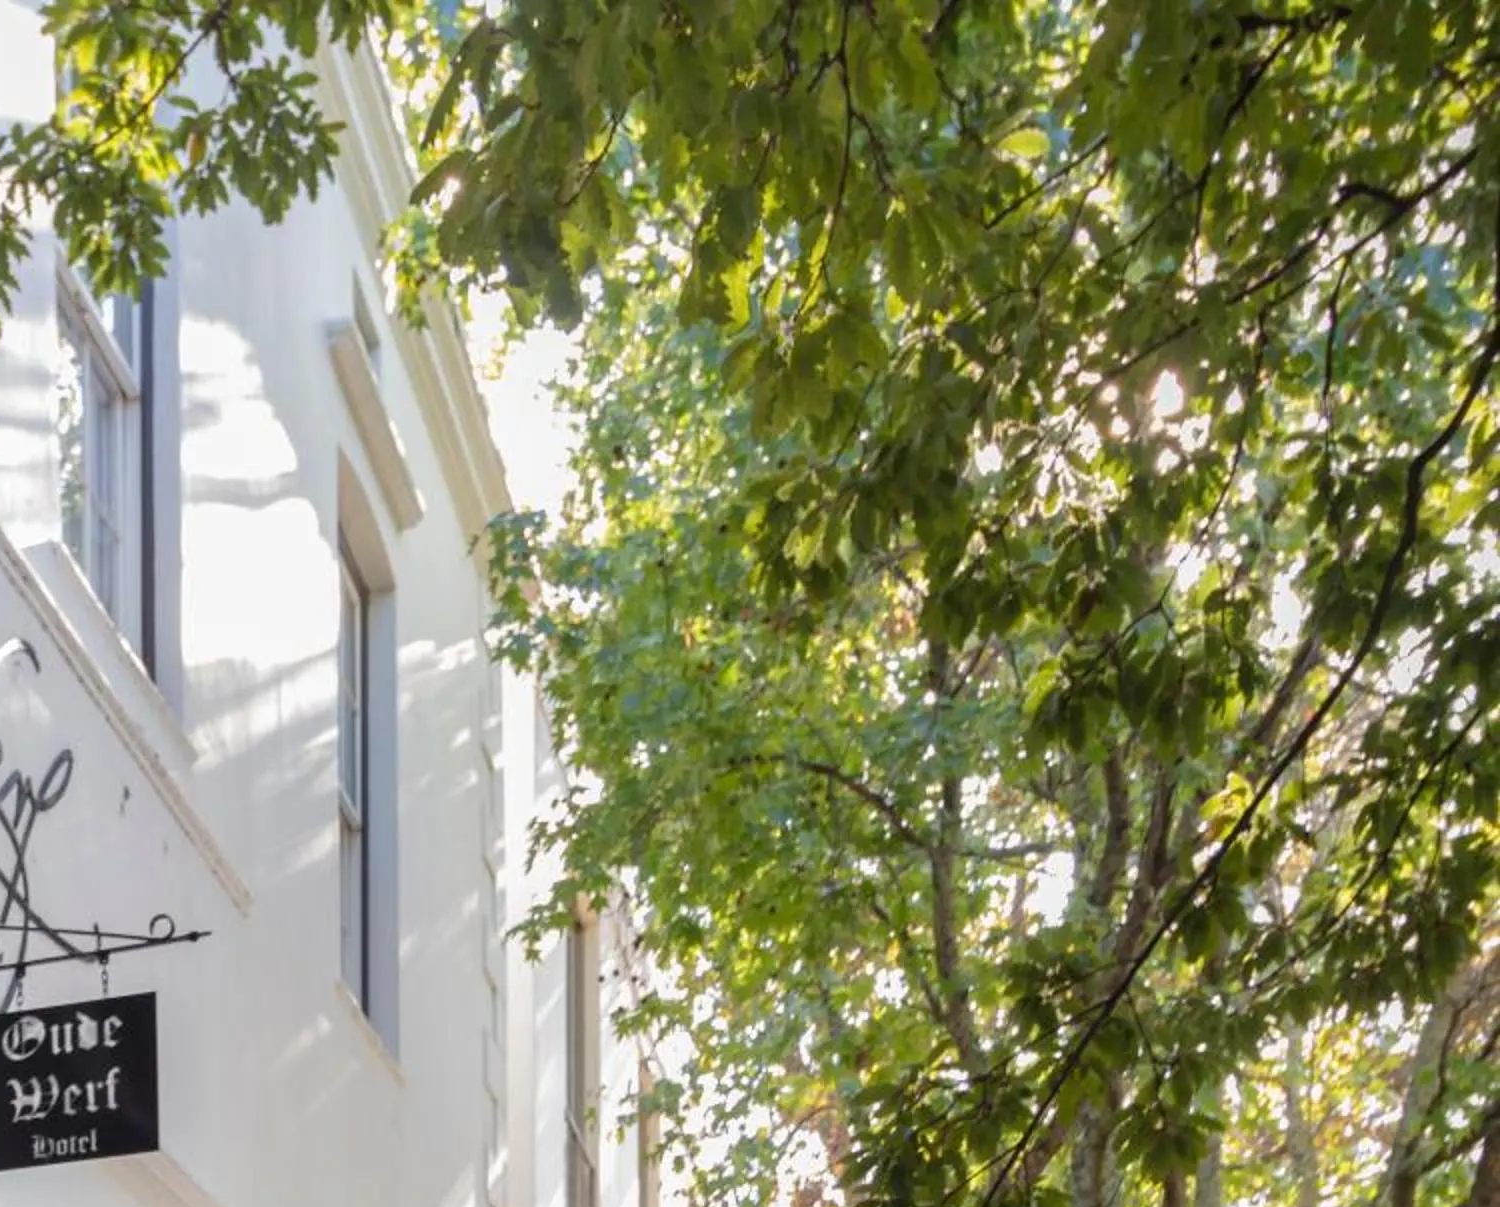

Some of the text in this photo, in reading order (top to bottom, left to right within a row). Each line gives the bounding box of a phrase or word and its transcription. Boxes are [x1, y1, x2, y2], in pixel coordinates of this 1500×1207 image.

[2, 1010, 123, 1062] Oude
[7, 1066, 121, 1123] Werf
[30, 1127, 98, 1159] Hotel
